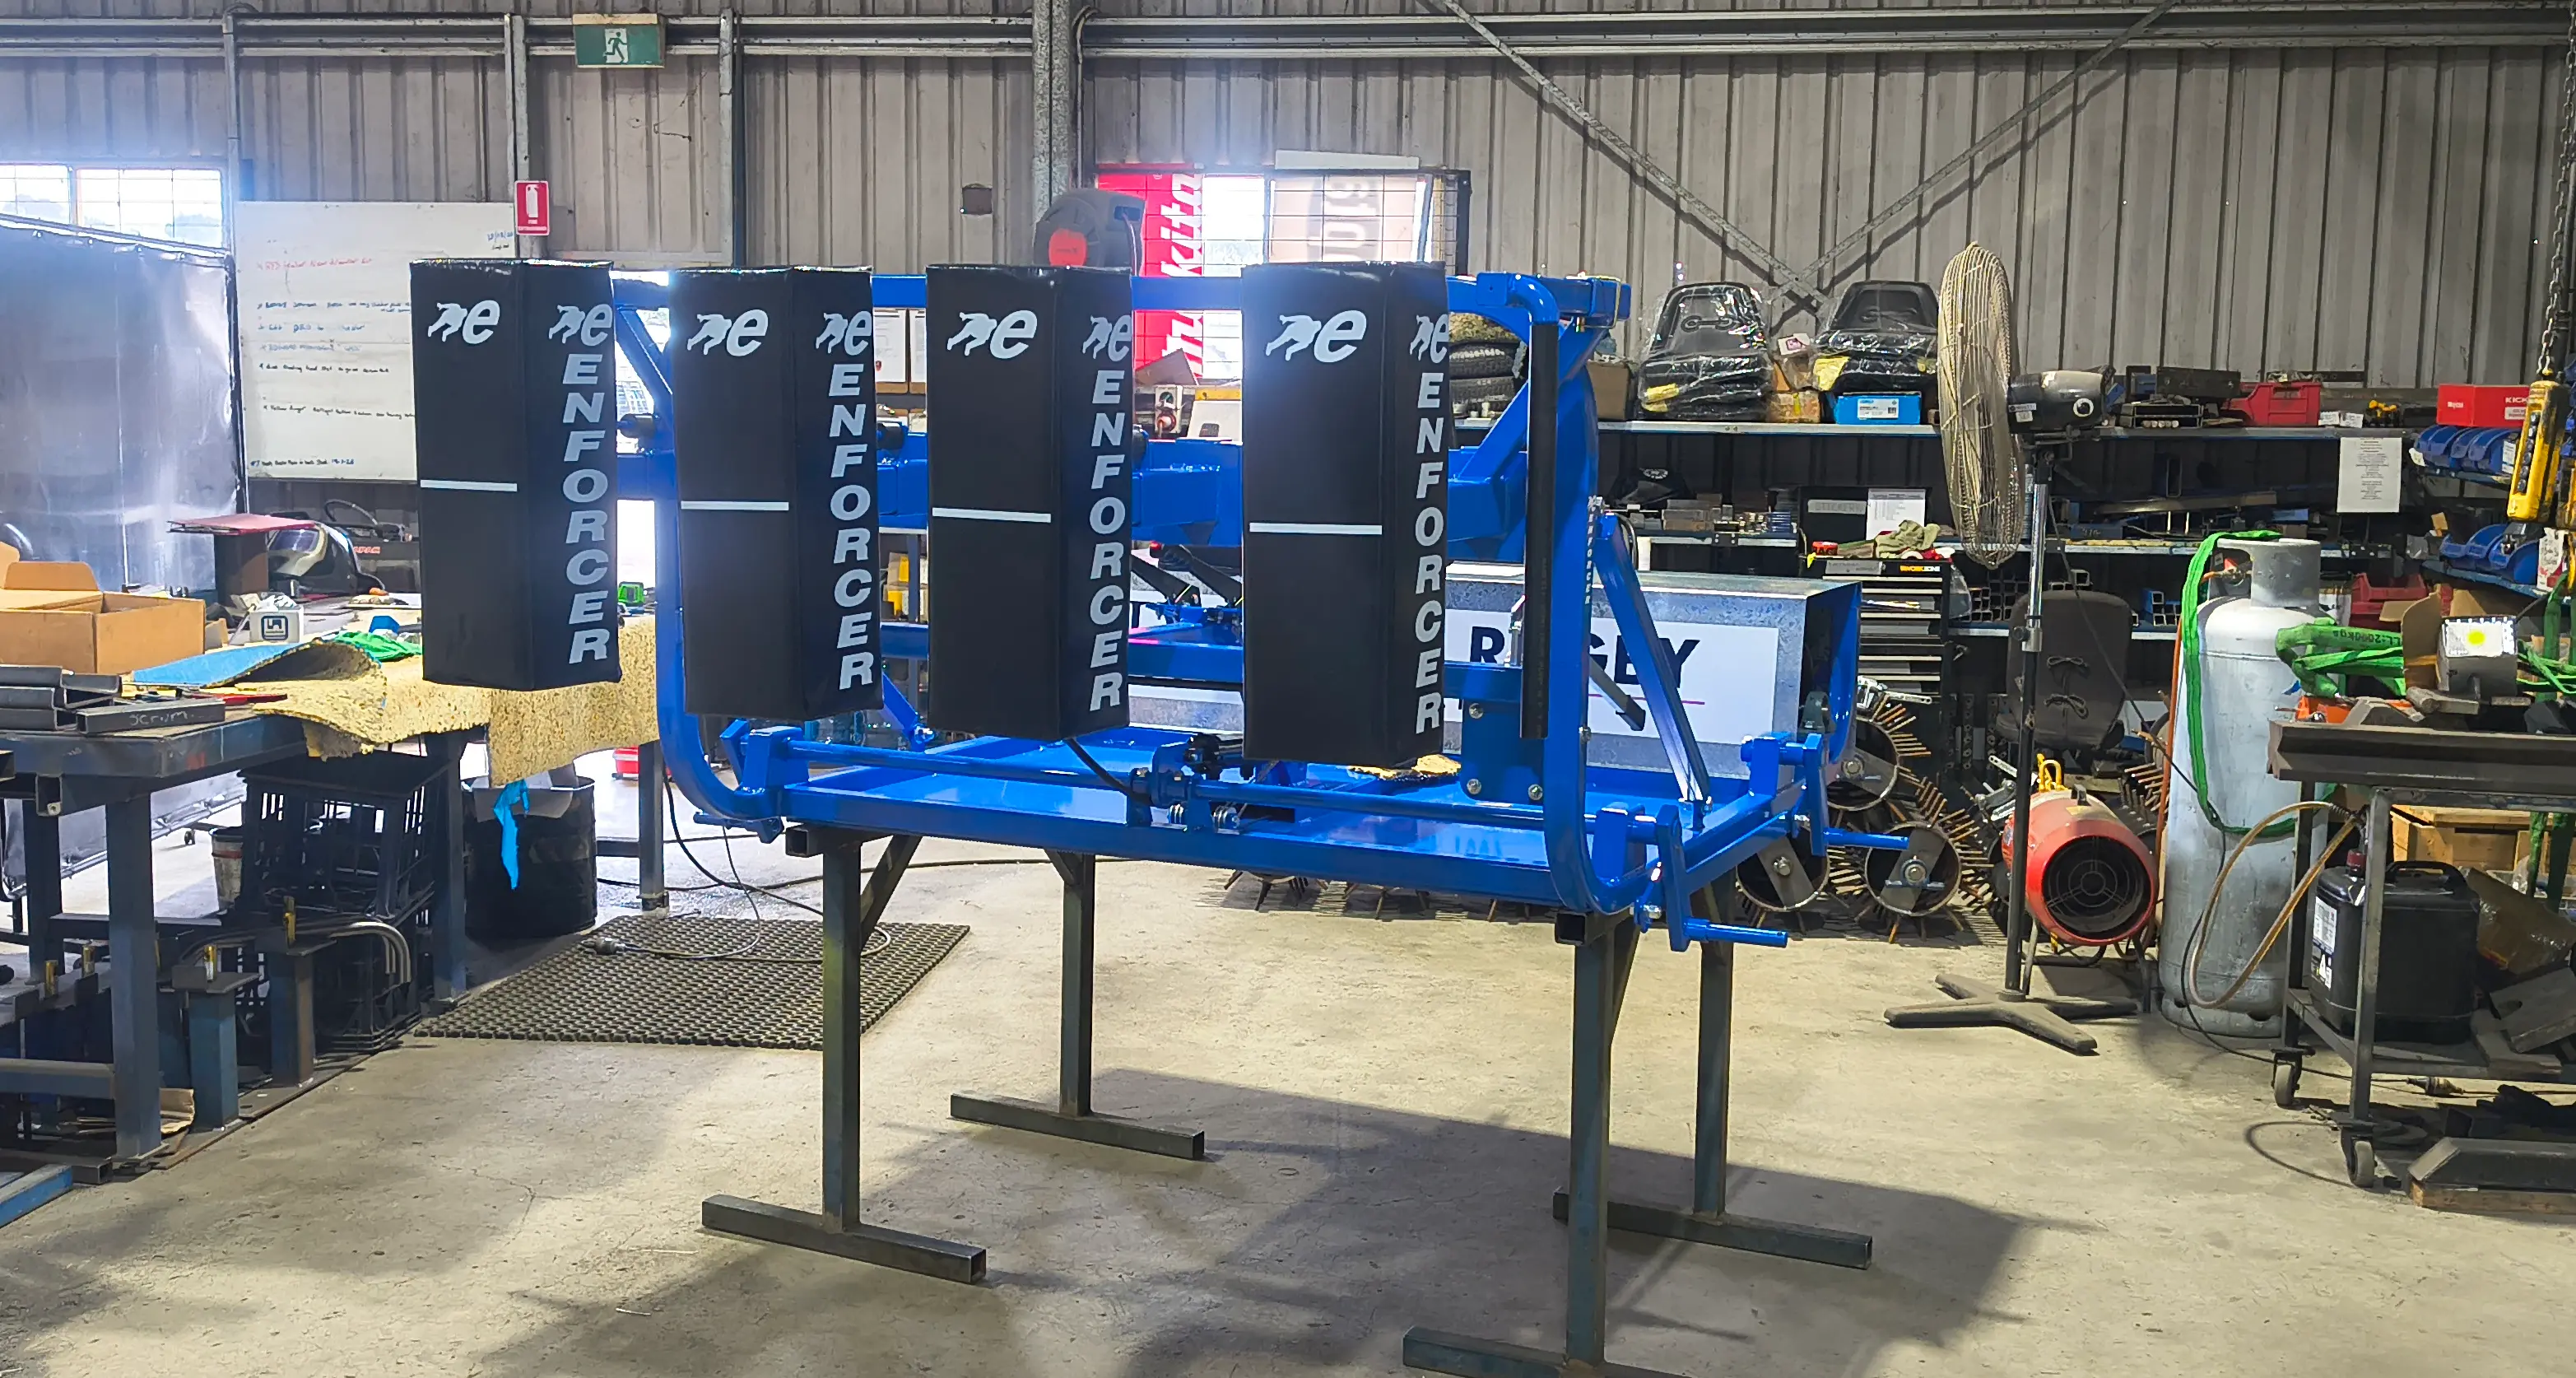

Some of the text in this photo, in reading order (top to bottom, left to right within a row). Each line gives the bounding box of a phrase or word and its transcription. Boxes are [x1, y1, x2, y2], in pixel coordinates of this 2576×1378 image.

[563, 354, 610, 663] ENFORCER
[829, 364, 873, 689] ENFORCER
[1090, 370, 1125, 710] ENFORCER
[1416, 373, 1444, 733] ENFORCER
